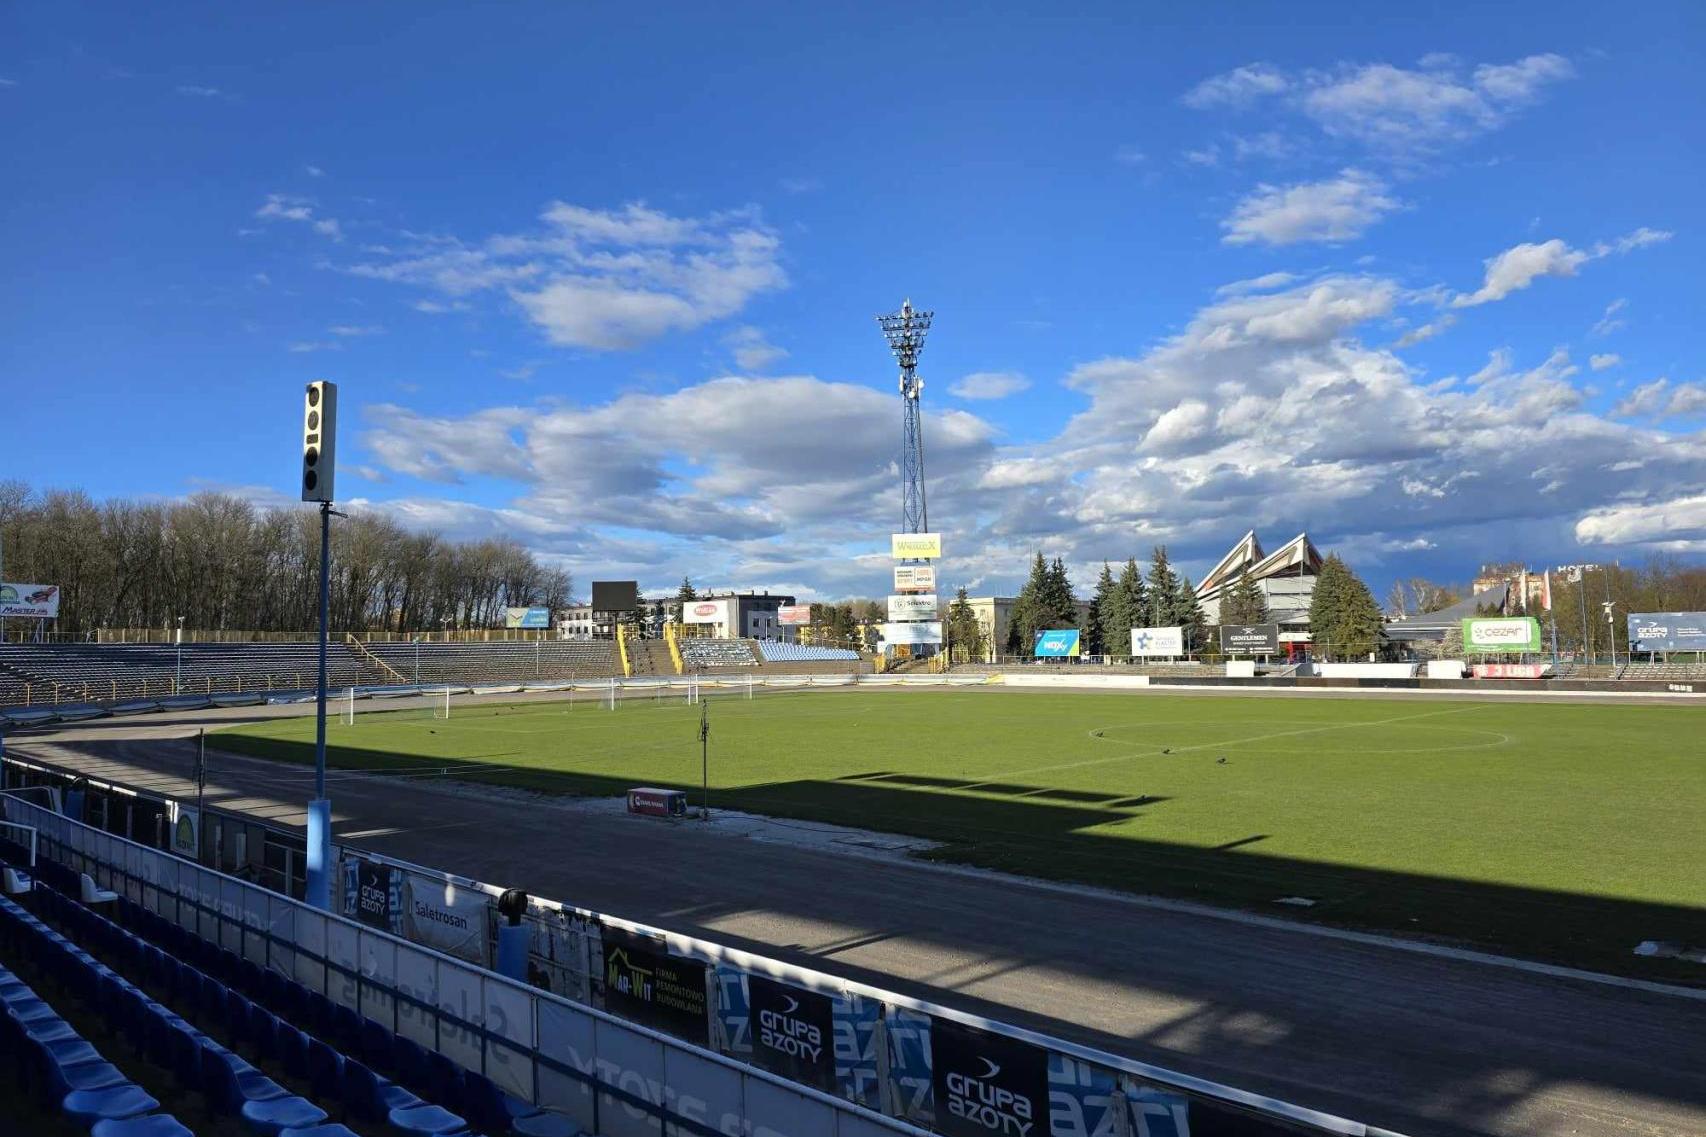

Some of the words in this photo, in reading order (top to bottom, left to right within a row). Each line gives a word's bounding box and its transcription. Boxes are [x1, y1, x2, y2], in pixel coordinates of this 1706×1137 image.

[1558, 564, 1602, 573] HOTEL
[361, 884, 385, 903] GRUPA
[361, 896, 386, 915] AZOTY
[415, 901, 468, 930] Saletrosan
[655, 967, 678, 981] FIRMA
[760, 1009, 822, 1045] GRUPA
[760, 1027, 823, 1064] AZOTY
[946, 1072, 1032, 1120] GRUPA
[948, 1093, 1034, 1137] AZOTY
